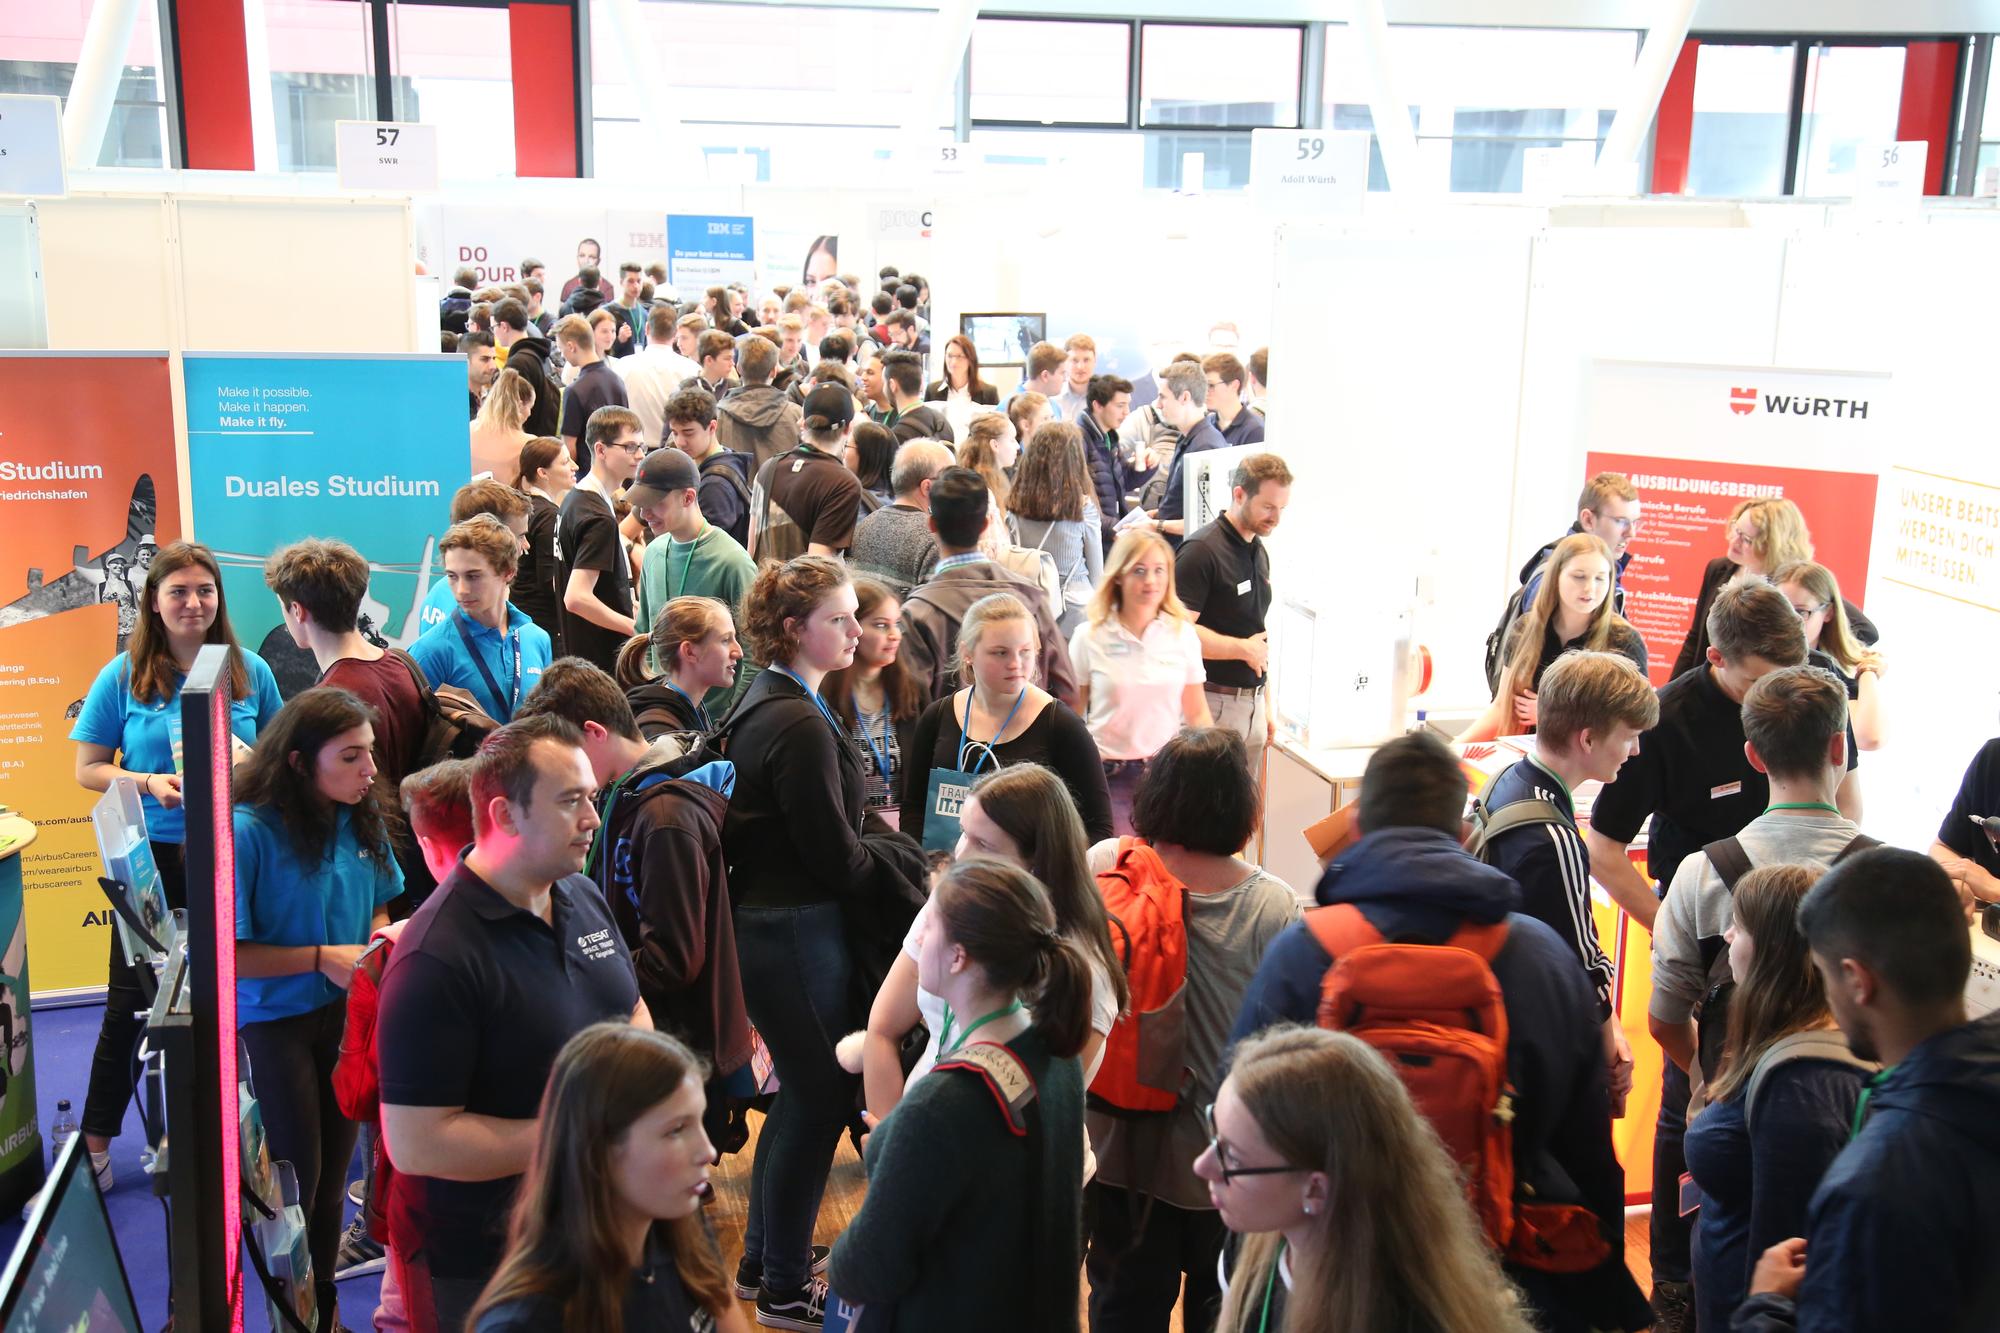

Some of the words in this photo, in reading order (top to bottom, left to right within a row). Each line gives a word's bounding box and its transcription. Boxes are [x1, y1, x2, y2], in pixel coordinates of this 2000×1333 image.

[377, 128, 400, 146] 57
[941, 147, 957, 160] 53
[1297, 138, 1325, 160] 59
[1881, 145, 1899, 168] 56
[379, 157, 398, 165] SWR
[1281, 175, 1305, 184] Adolf
[707, 222, 730, 235] IBM
[629, 232, 664, 248] IBM
[459, 246, 487, 262] DO
[475, 266, 515, 282] OUR
[218, 386, 250, 398] Make
[252, 386, 260, 398] it
[263, 386, 312, 400] possible.
[219, 401, 250, 412] Make
[253, 401, 260, 412] it
[264, 402, 309, 414] happen.
[1765, 395, 1868, 419] WÜRTH
[220, 416, 254, 427] Make
[258, 416, 266, 427] it
[269, 416, 287, 429] fly.
[0, 461, 103, 480] Studium
[225, 475, 320, 497] Duales
[328, 474, 440, 497] Studium
[1631, 473, 1784, 499] AUSBILDUNGSBERUFE
[1673, 503, 1706, 514] Berufe
[1901, 487, 1953, 517] UNSERE
[1957, 499, 2000, 528] BEATS
[1900, 519, 1956, 548] WERDEN
[1961, 532, 1994, 559] DICH
[1633, 553, 1665, 565] Berufe
[27, 676, 60, 686] (B.Eng.)
[584, 929, 610, 944] TESAT
